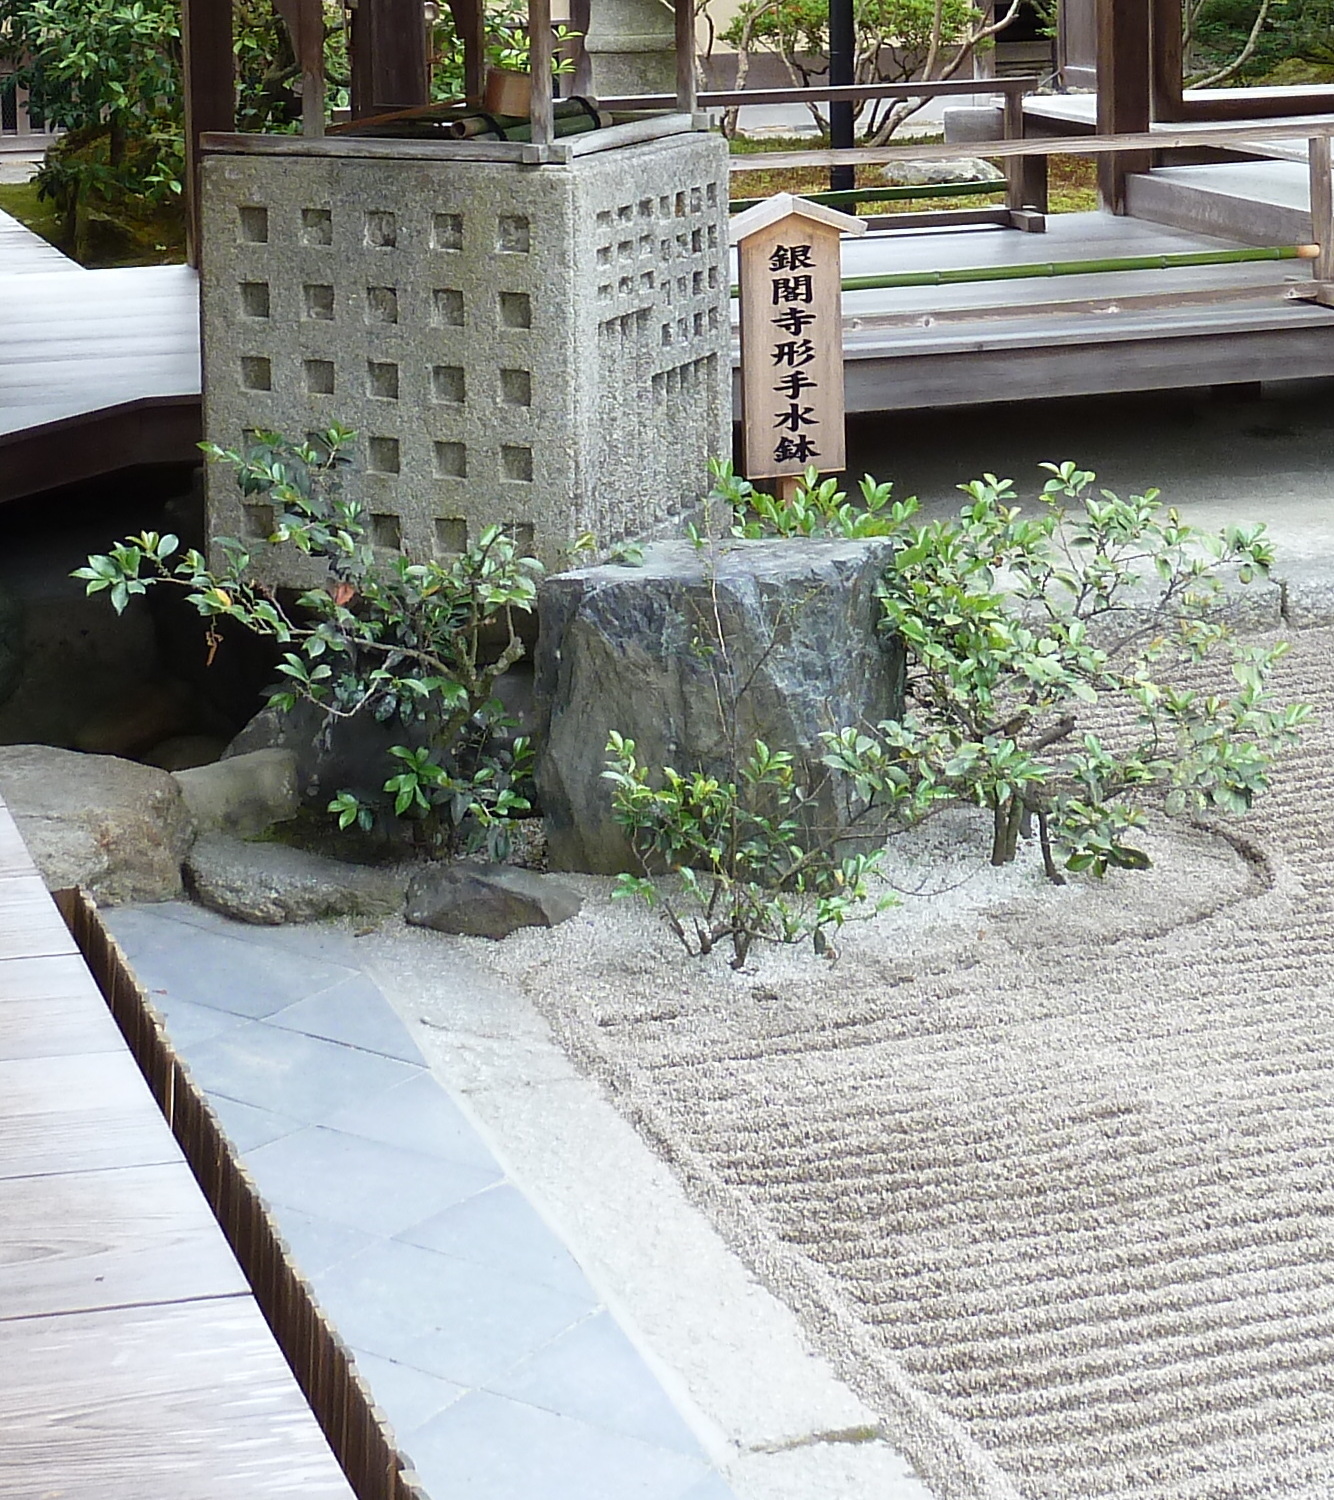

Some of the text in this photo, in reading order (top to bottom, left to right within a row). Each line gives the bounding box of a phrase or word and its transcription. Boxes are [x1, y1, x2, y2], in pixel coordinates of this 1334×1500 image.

[768, 244, 820, 463] 銀閣寺形手水鉢
